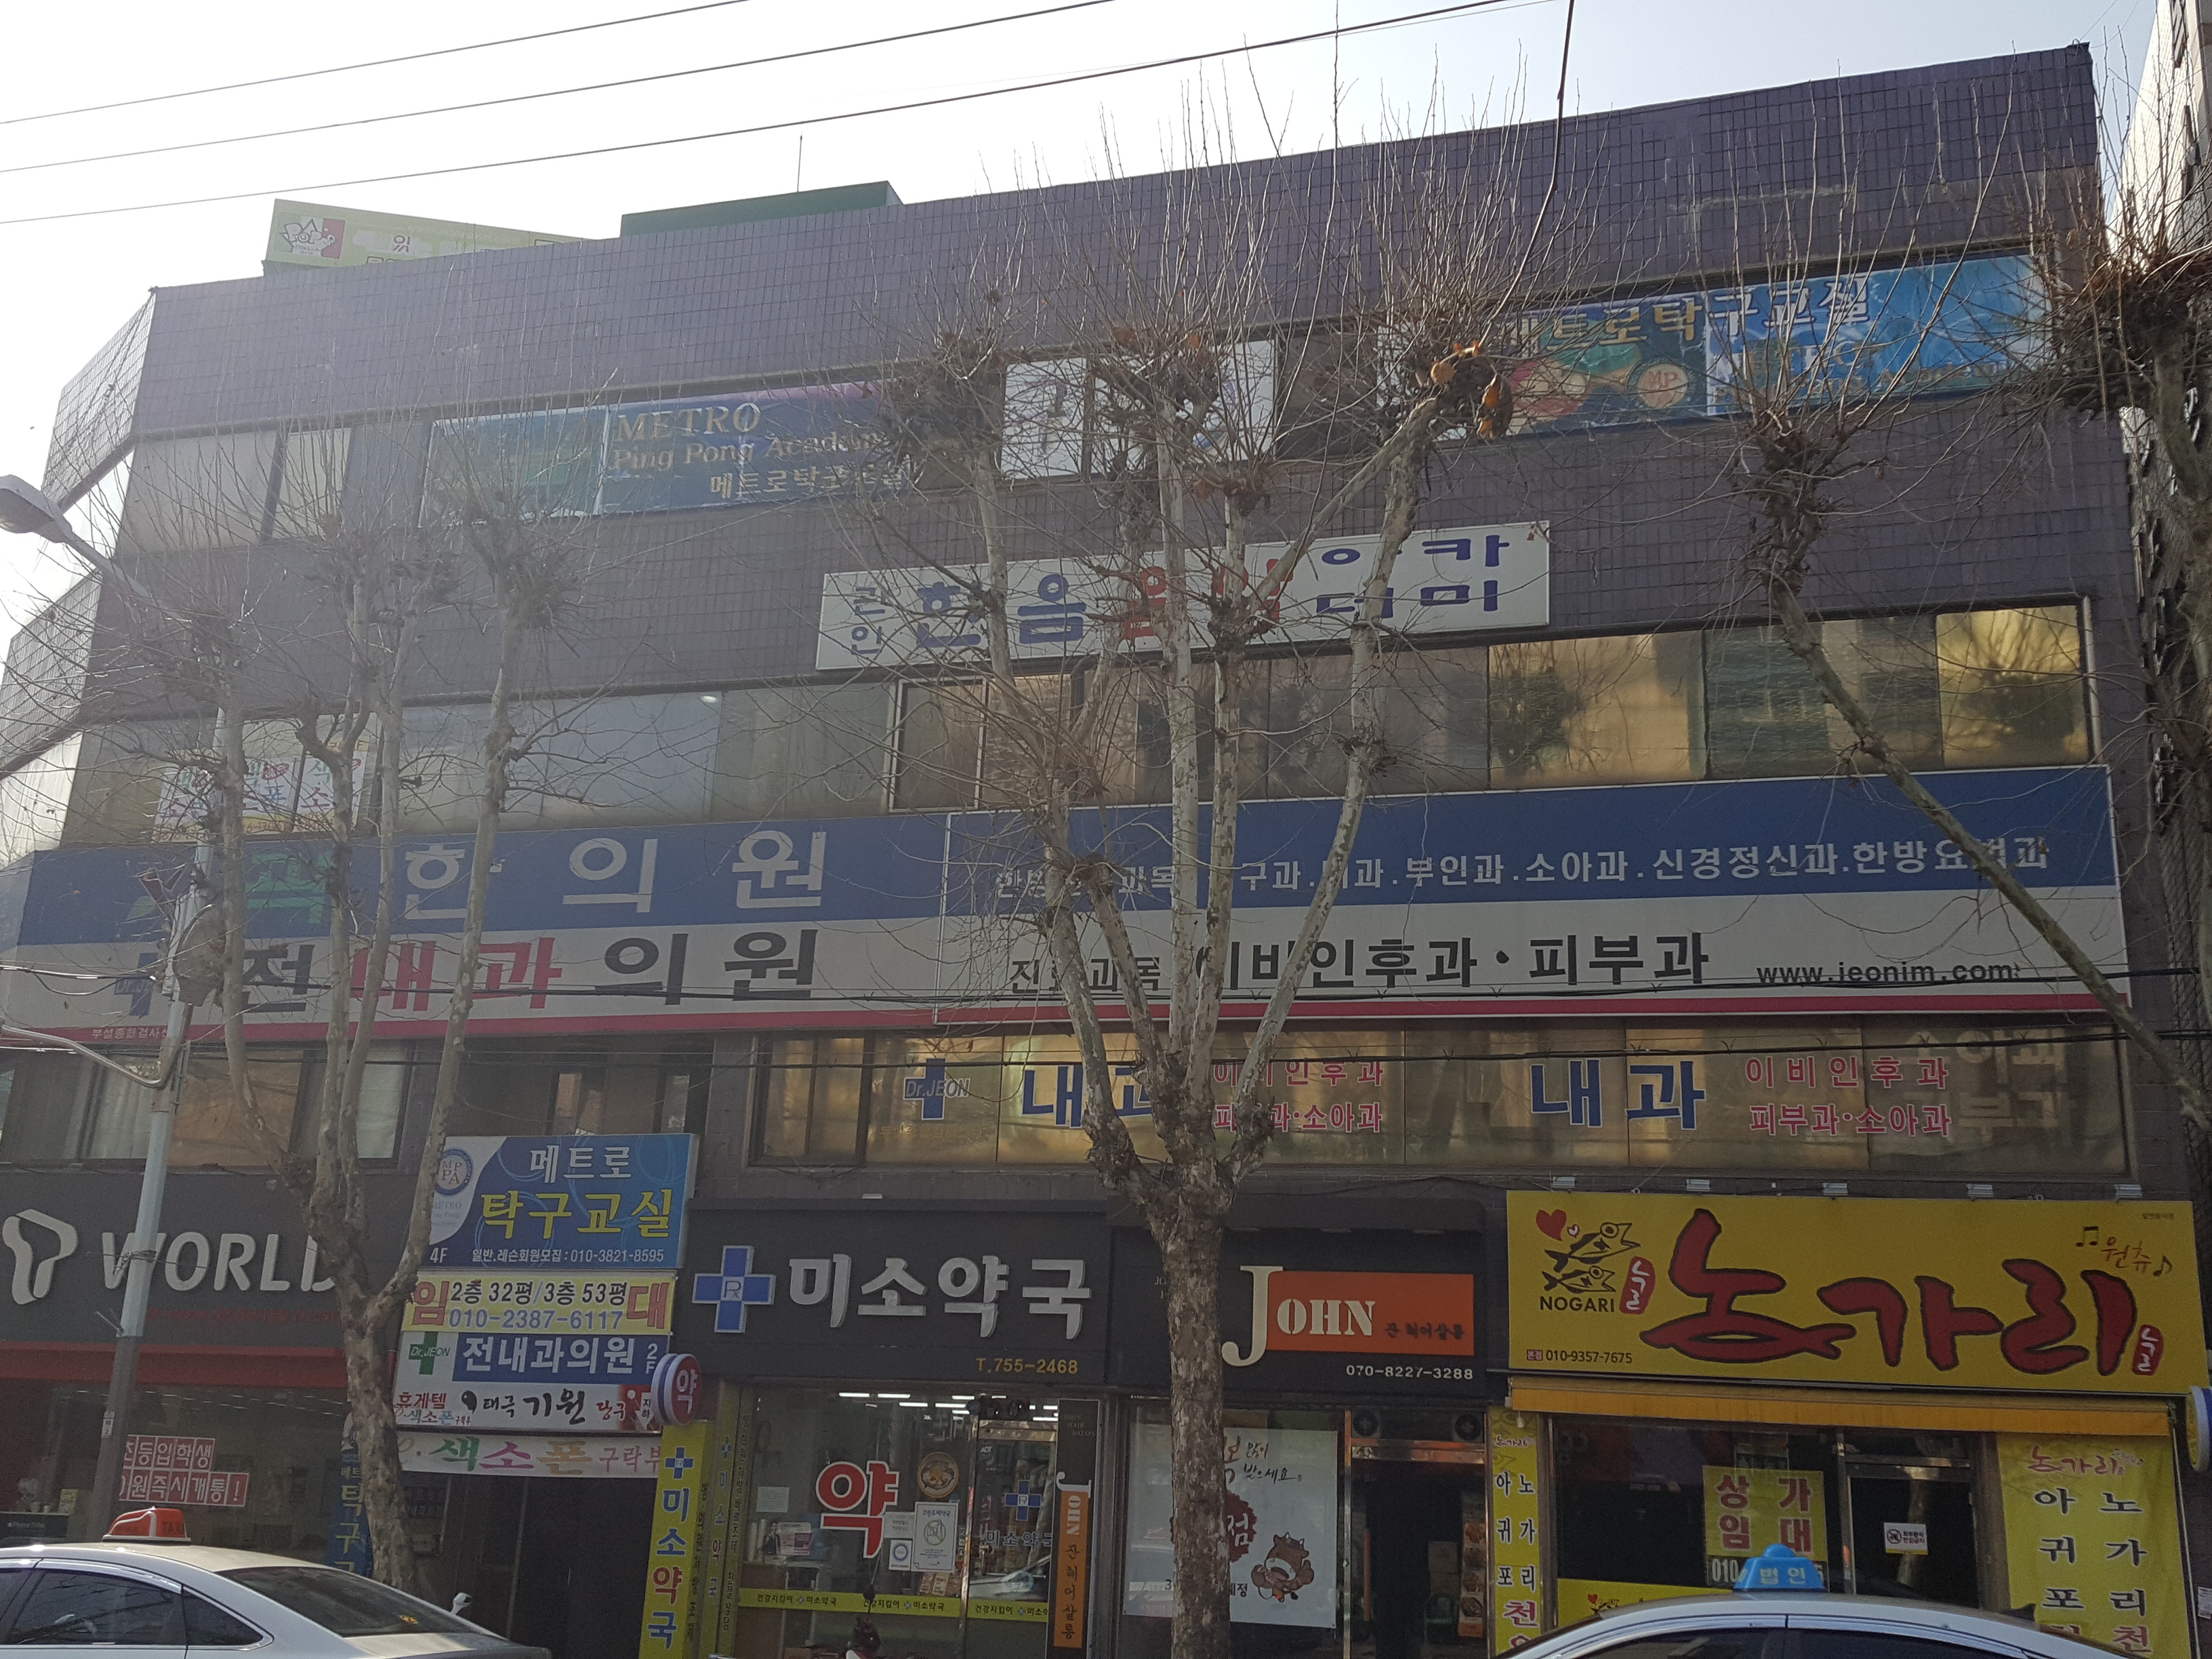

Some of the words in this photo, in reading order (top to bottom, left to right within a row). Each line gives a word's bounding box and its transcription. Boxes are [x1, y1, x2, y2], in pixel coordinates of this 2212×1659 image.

[615, 402, 761, 444] METRO
[613, 447, 674, 472] Ping
[684, 439, 756, 466] Pong
[905, 1077, 971, 1099] Dr.JEON
[1744, 1055, 1949, 1089] 이비인후과
[1530, 1059, 1706, 1130] 내과
[529, 1144, 632, 1185] 메트로
[480, 1188, 674, 1240] 탁구교실
[430, 1247, 449, 1264] 4F
[788, 1252, 1092, 1340] 미소약국
[1538, 1294, 1616, 1313] NOGARI
[1639, 1207, 2138, 1376] 노가리
[448, 1308, 624, 1330] 010-2387-6117
[1221, 1265, 1376, 1368] JOHN
[462, 1336, 636, 1374] 전내과의원
[1345, 1364, 1474, 1380] 070-8227-3288
[1546, 1349, 1633, 1364] 010-9357-7675
[676, 1368, 699, 1415] 약
[815, 1460, 901, 1559] 약
[647, 1487, 691, 1651] 미소약국
[2034, 1488, 2086, 1610] 아귀포
[2098, 1492, 2149, 1618] 노가리
